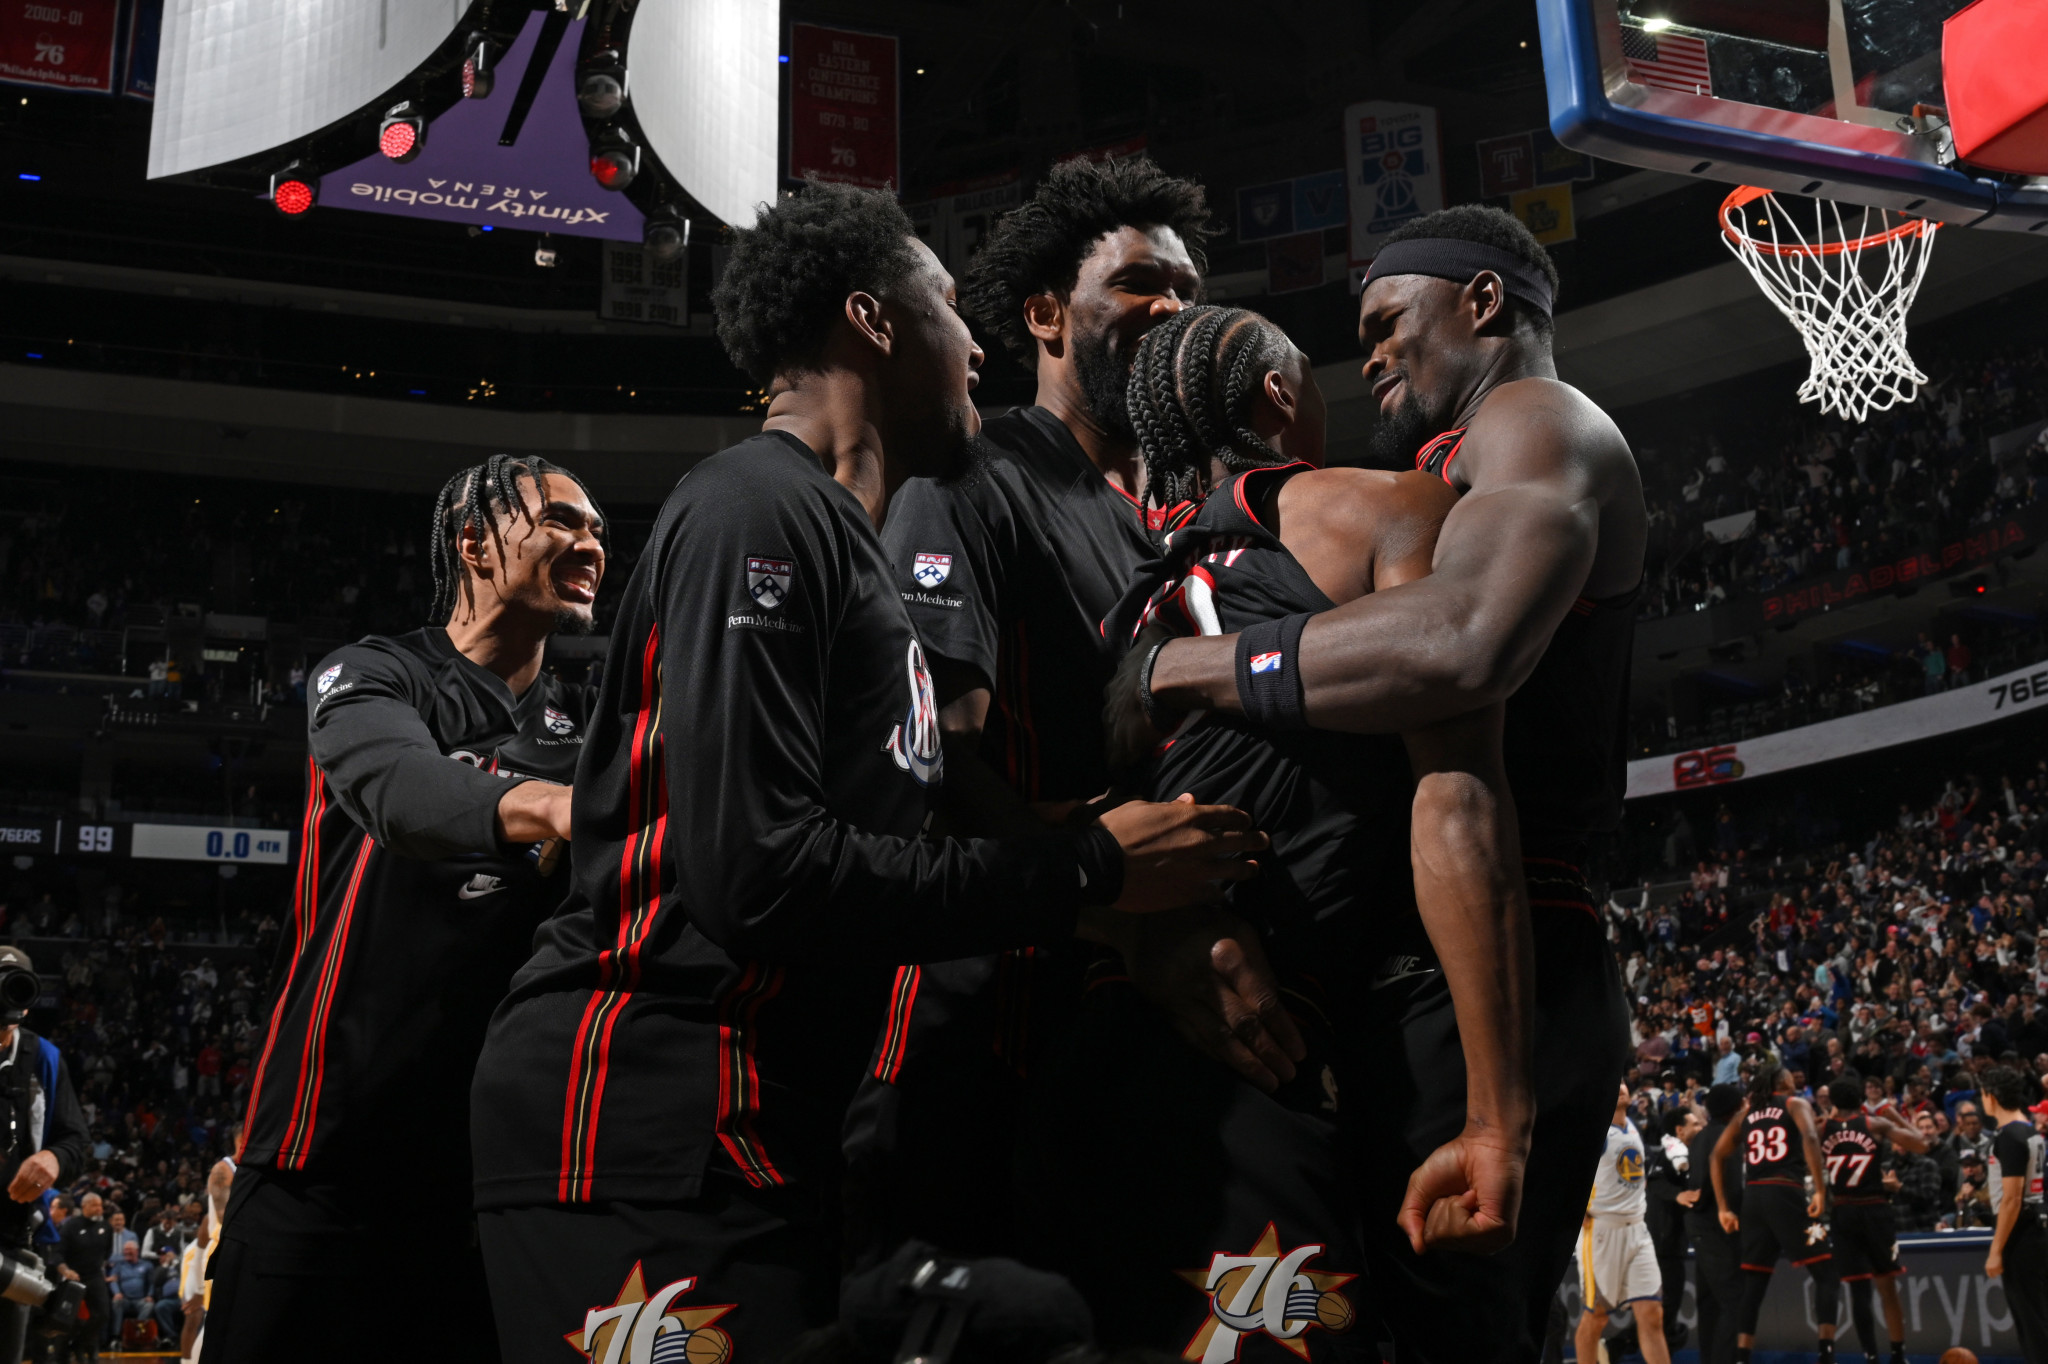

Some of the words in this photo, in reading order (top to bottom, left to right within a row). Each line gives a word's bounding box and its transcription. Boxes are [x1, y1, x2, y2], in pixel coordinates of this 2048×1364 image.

[34, 41, 65, 66] 76
[832, 40, 856, 56] NBA
[817, 53, 871, 73] EASTERN
[808, 67, 880, 91] CONFERENCE
[810, 82, 878, 105] CHAMPIONS
[1380, 112, 1420, 127] TOYOTA
[1361, 125, 1422, 154] BIG
[831, 146, 856, 168] 76
[350, 182, 480, 209] mobile
[428, 178, 548, 201] ARENA
[487, 199, 610, 225] xfinity
[1762, 521, 2025, 621] PHILADELPHIA
[915, 592, 962, 607] Medicine
[728, 615, 754, 628] Penn
[756, 616, 806, 634] Medicine
[536, 737, 559, 746] Penn
[0, 827, 42, 844] 76ERS
[78, 825, 114, 852] 99
[206, 831, 250, 858] 0.0
[257, 840, 281, 853] 4TH
[1747, 1125, 1790, 1165] 33
[1821, 1130, 1878, 1155] EDGECOMBE
[1826, 1153, 1875, 1188] 77
[1205, 1245, 1321, 1364] 76
[1871, 1271, 2014, 1346] cryp
[584, 1279, 692, 1364] 76
